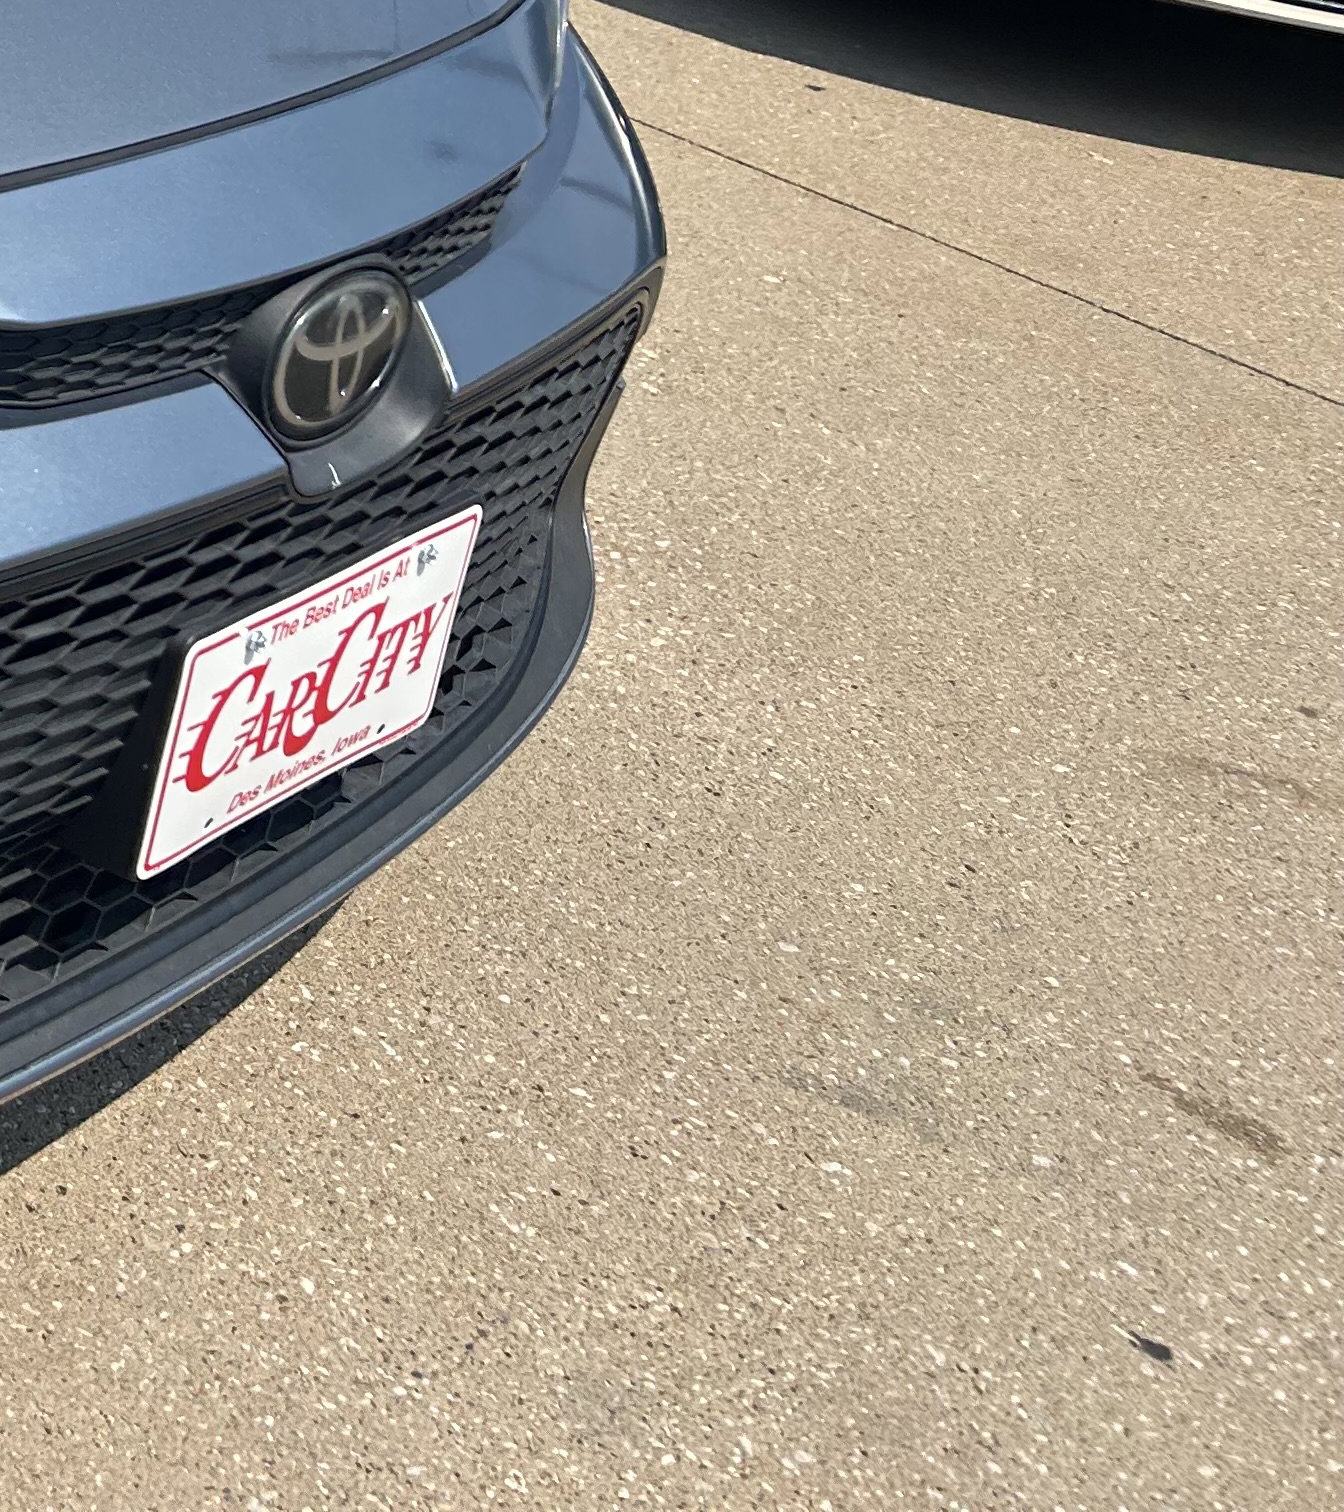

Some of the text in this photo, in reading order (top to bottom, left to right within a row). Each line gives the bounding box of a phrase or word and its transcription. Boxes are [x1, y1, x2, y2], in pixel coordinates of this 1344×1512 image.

[270, 556, 411, 646] The Best Deal Is At
[226, 724, 372, 814] Des Moines, Iowa
